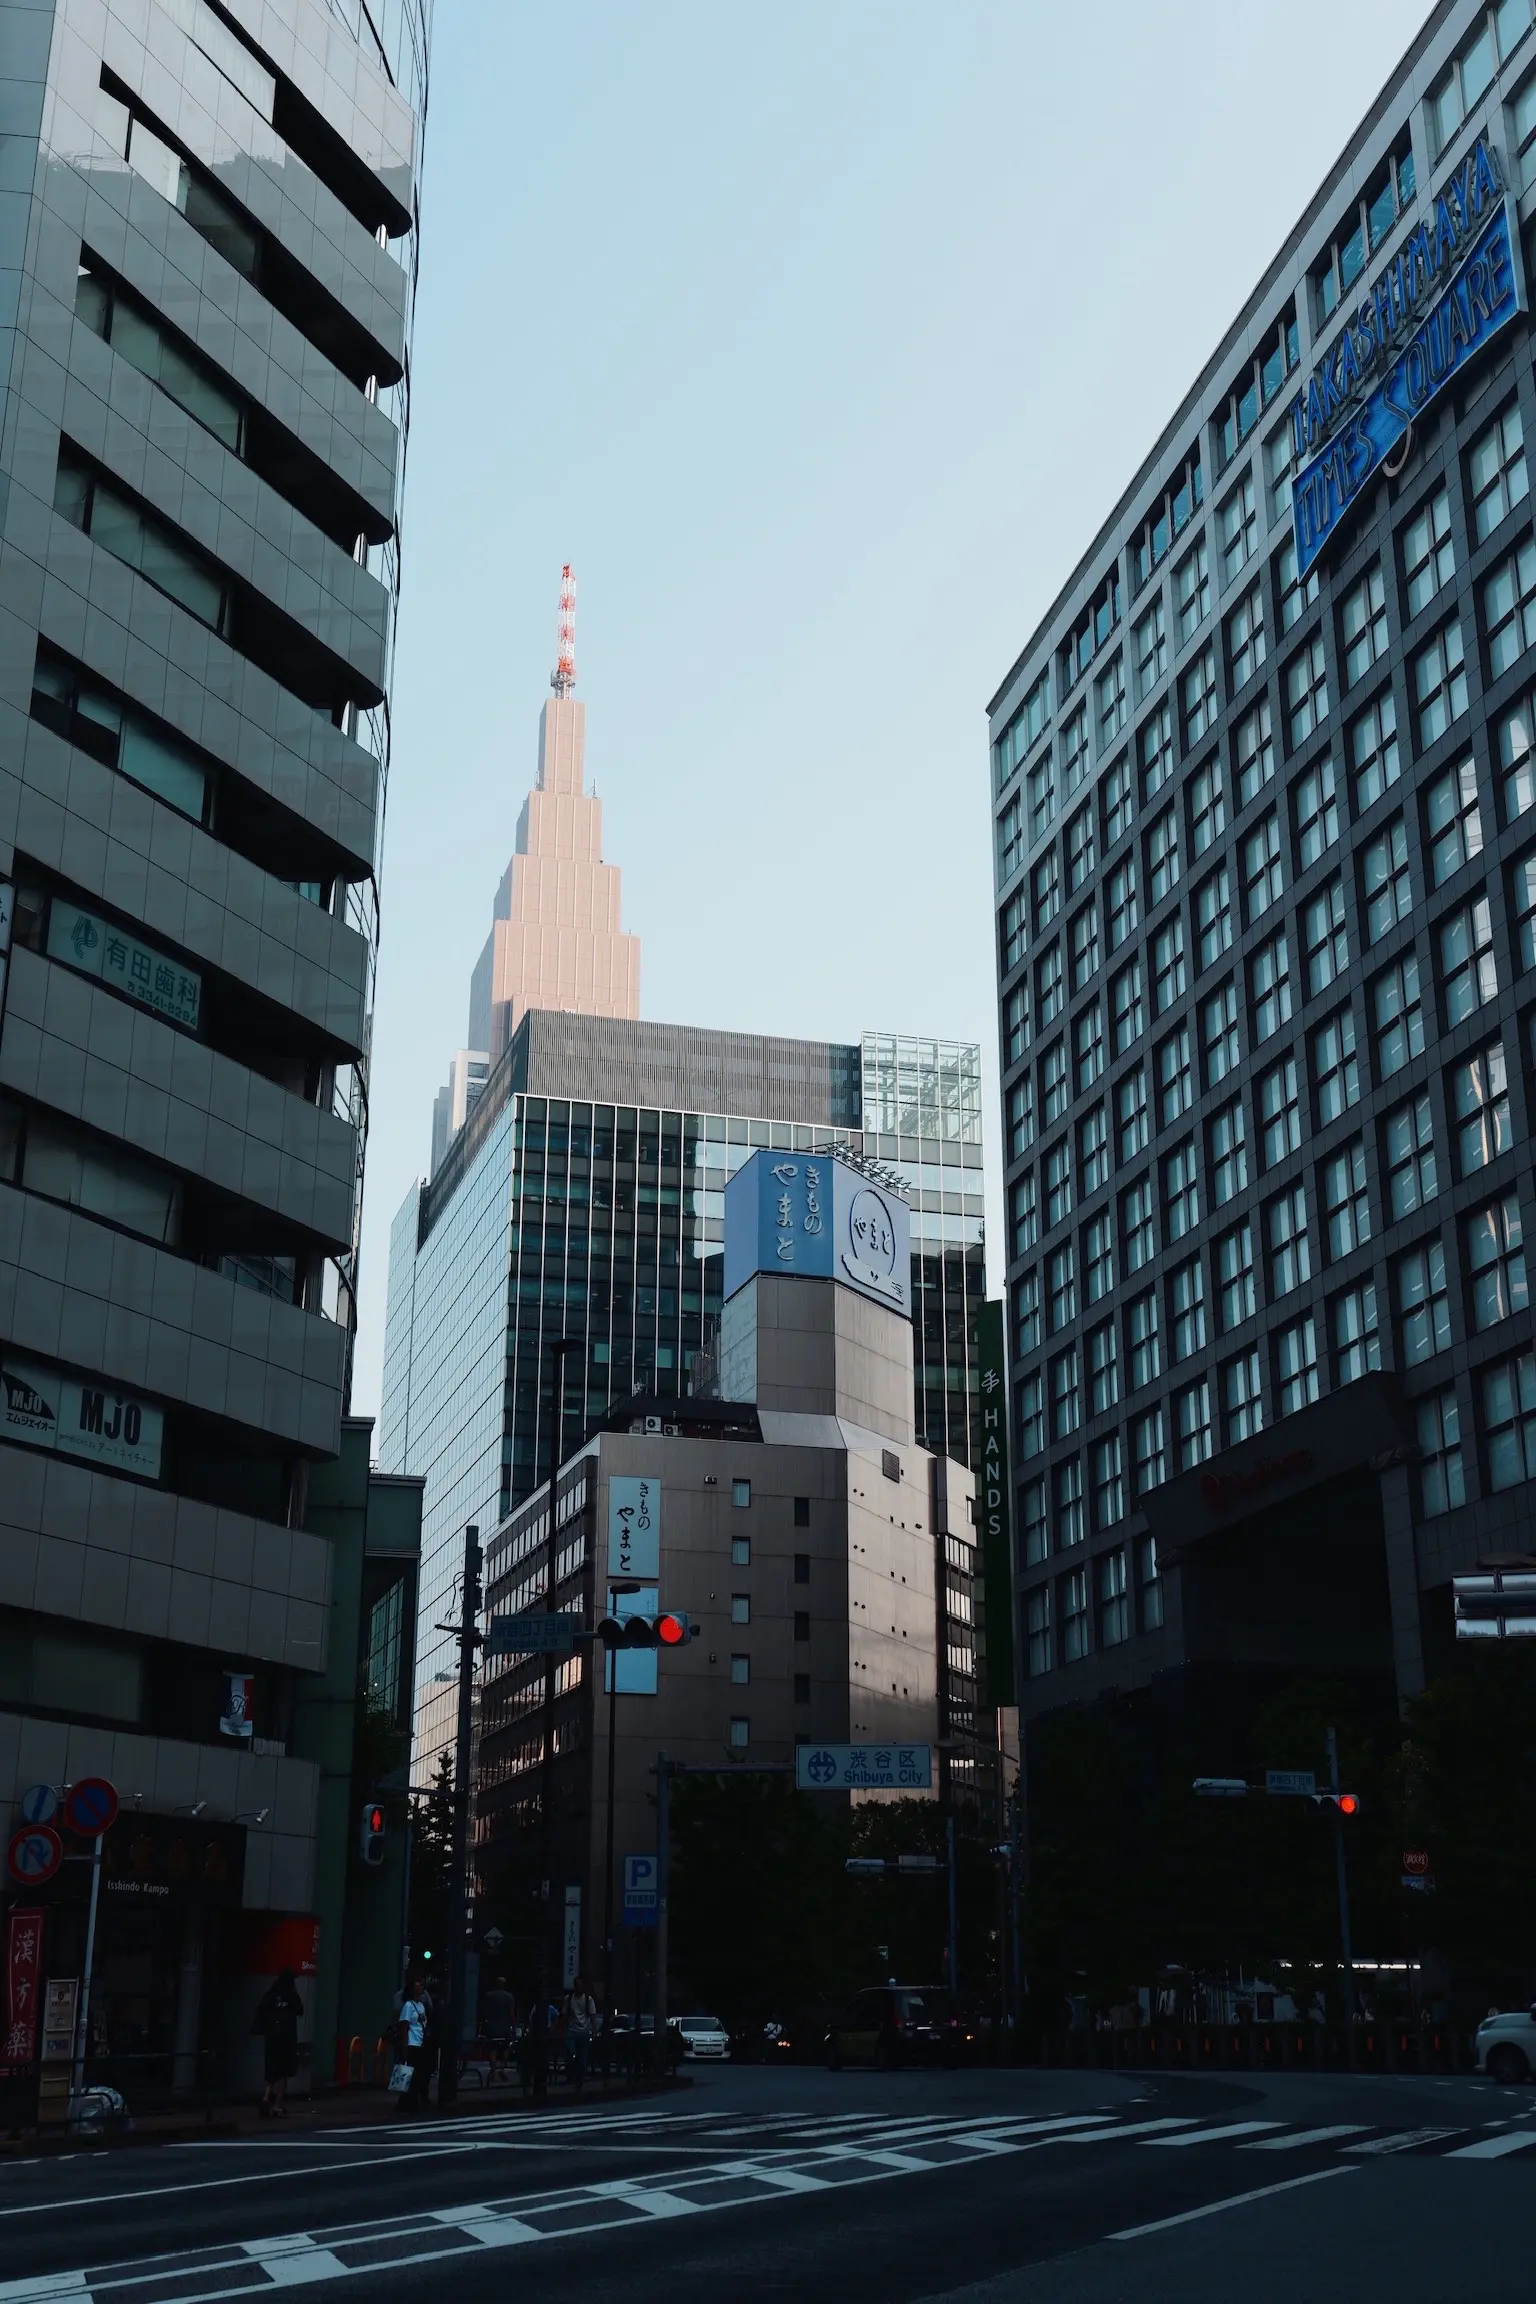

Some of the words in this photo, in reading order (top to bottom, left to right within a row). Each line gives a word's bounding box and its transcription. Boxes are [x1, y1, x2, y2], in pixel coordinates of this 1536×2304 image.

[1290, 138, 1498, 457] TAKASHIMAYA
[1297, 406, 1376, 548] TIMES
[1382, 232, 1511, 479] SQUARE
[107, 937, 198, 1012] 有田歯科
[769, 1163, 799, 1262] やまと
[803, 1163, 823, 1235] きもの
[853, 1216, 891, 1256] やまと
[6, 1412, 56, 1432] エムジェイオー
[983, 1407, 1002, 1536] HANDS
[616, 1506, 635, 1571] やまと
[637, 1482, 651, 1531] きもの
[843, 1770, 893, 1784] Shibuya
[898, 1770, 923, 1784] City
[850, 1749, 916, 1769] 渋谷区
[107, 1879, 140, 1892] Isshindo
[143, 1881, 169, 1897] Kampo
[631, 1859, 652, 1887] P
[7, 1929, 35, 2060] 漢方薬
